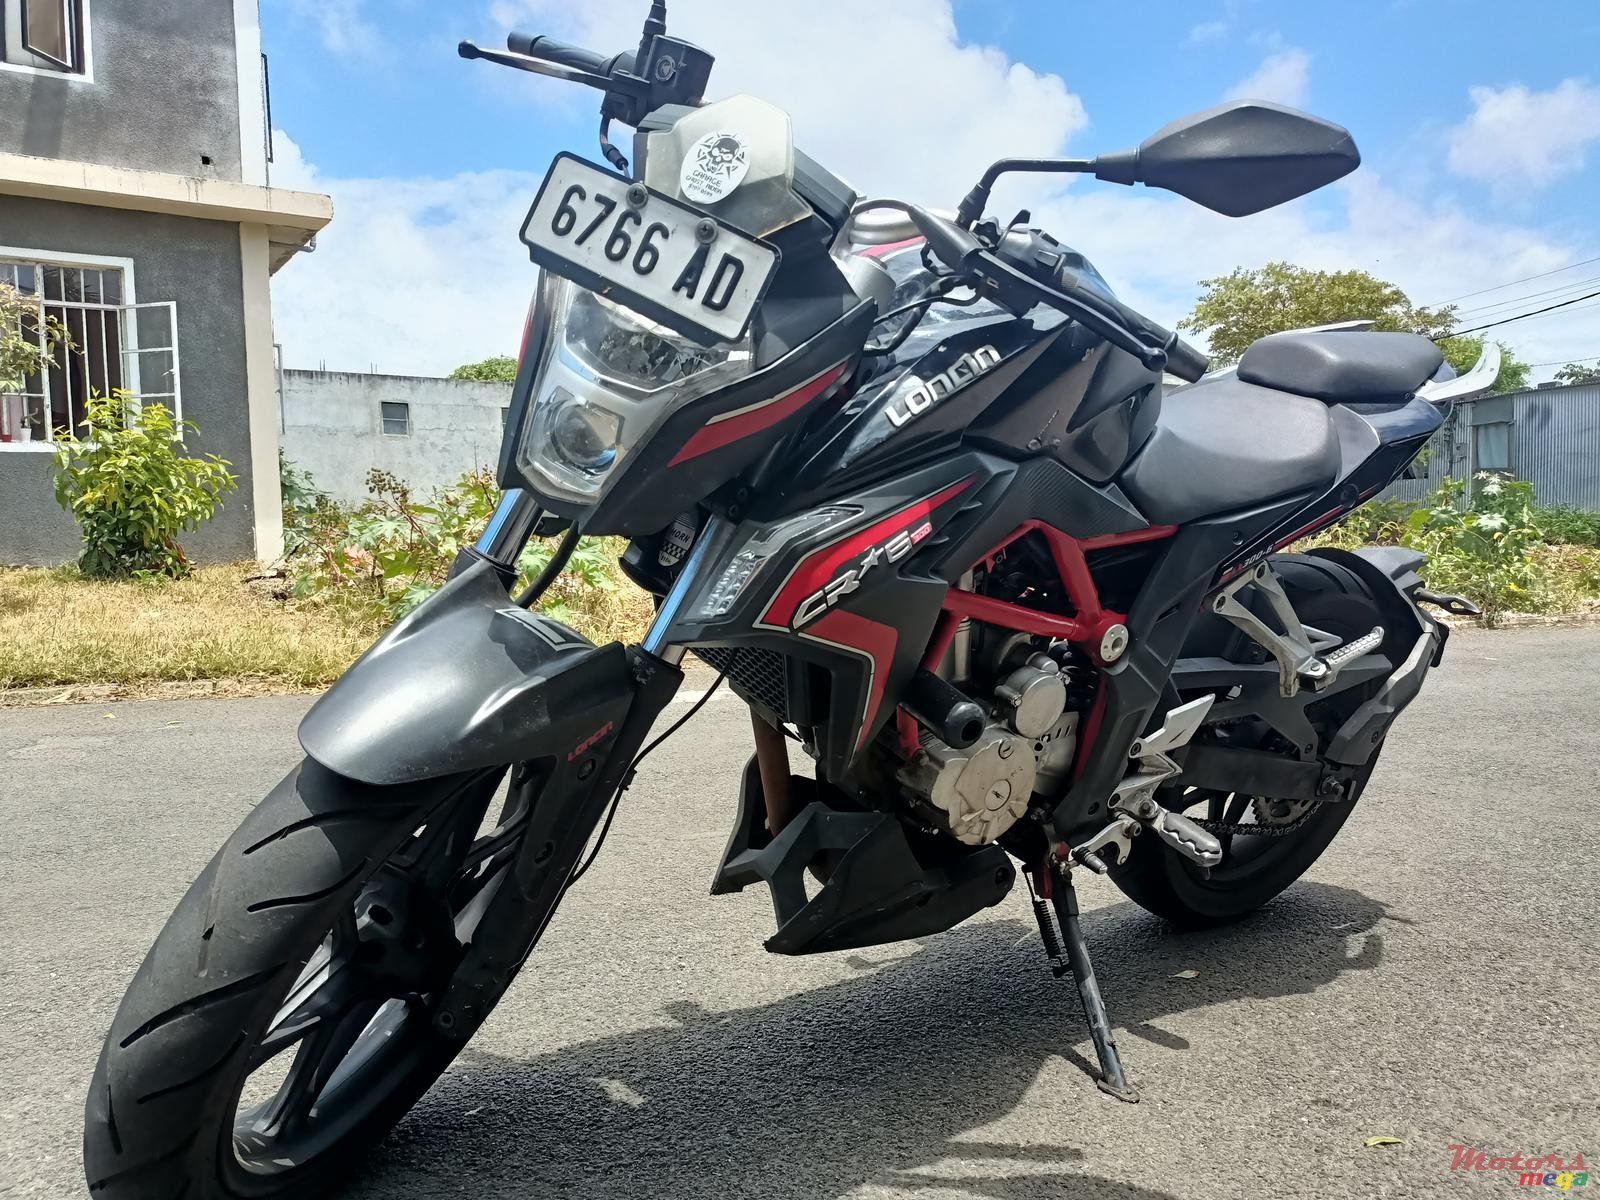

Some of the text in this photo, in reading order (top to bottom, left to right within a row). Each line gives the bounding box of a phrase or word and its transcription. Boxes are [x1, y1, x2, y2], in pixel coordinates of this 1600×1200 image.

[692, 170, 722, 187] GARAGE
[551, 184, 744, 312] 6766 AD
[671, 527, 691, 543] HORN
